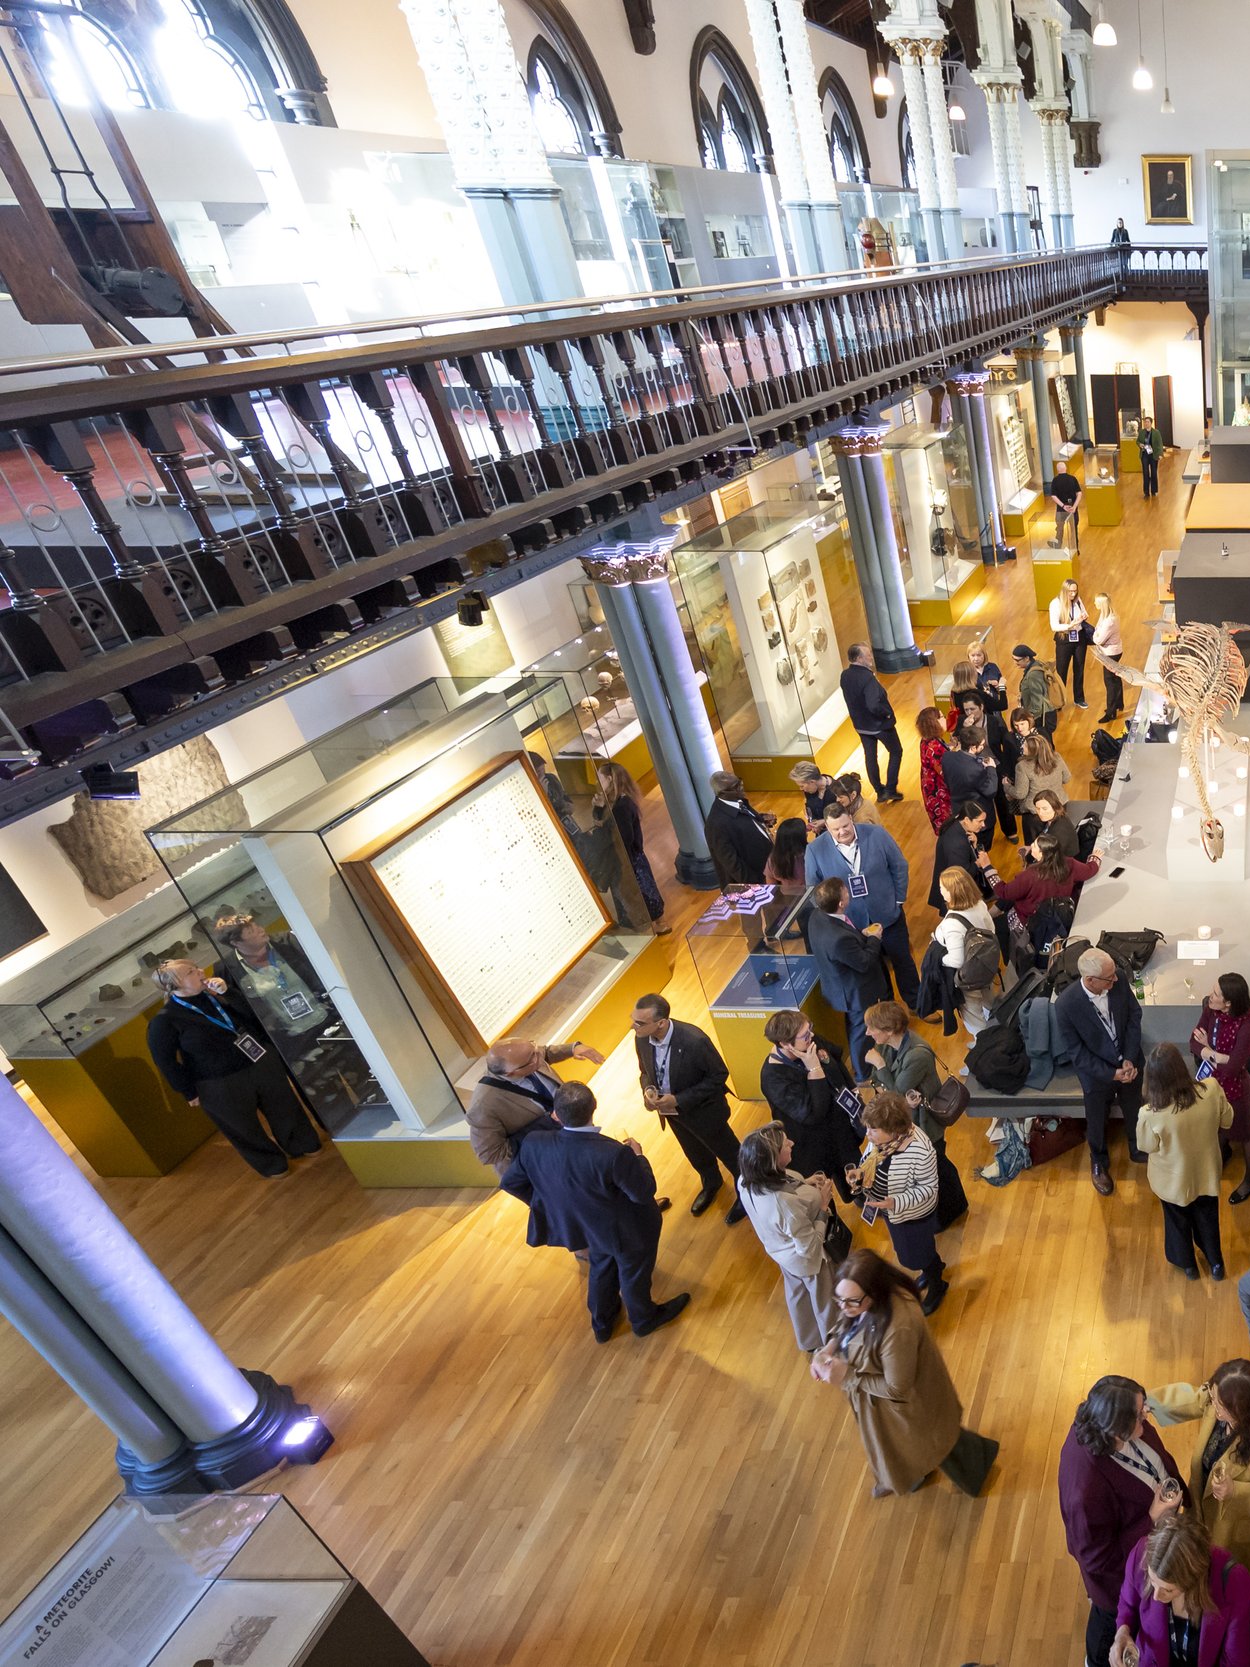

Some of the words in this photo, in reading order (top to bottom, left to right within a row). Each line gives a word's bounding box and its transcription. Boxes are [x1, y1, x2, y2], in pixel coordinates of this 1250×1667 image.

[23, 1628, 52, 1660] FALLS
[51, 1610, 68, 1629] ON
[68, 1555, 116, 1610] GLASGOW!
[35, 1624, 44, 1634] A
[43, 1567, 94, 1624] METEORITE
